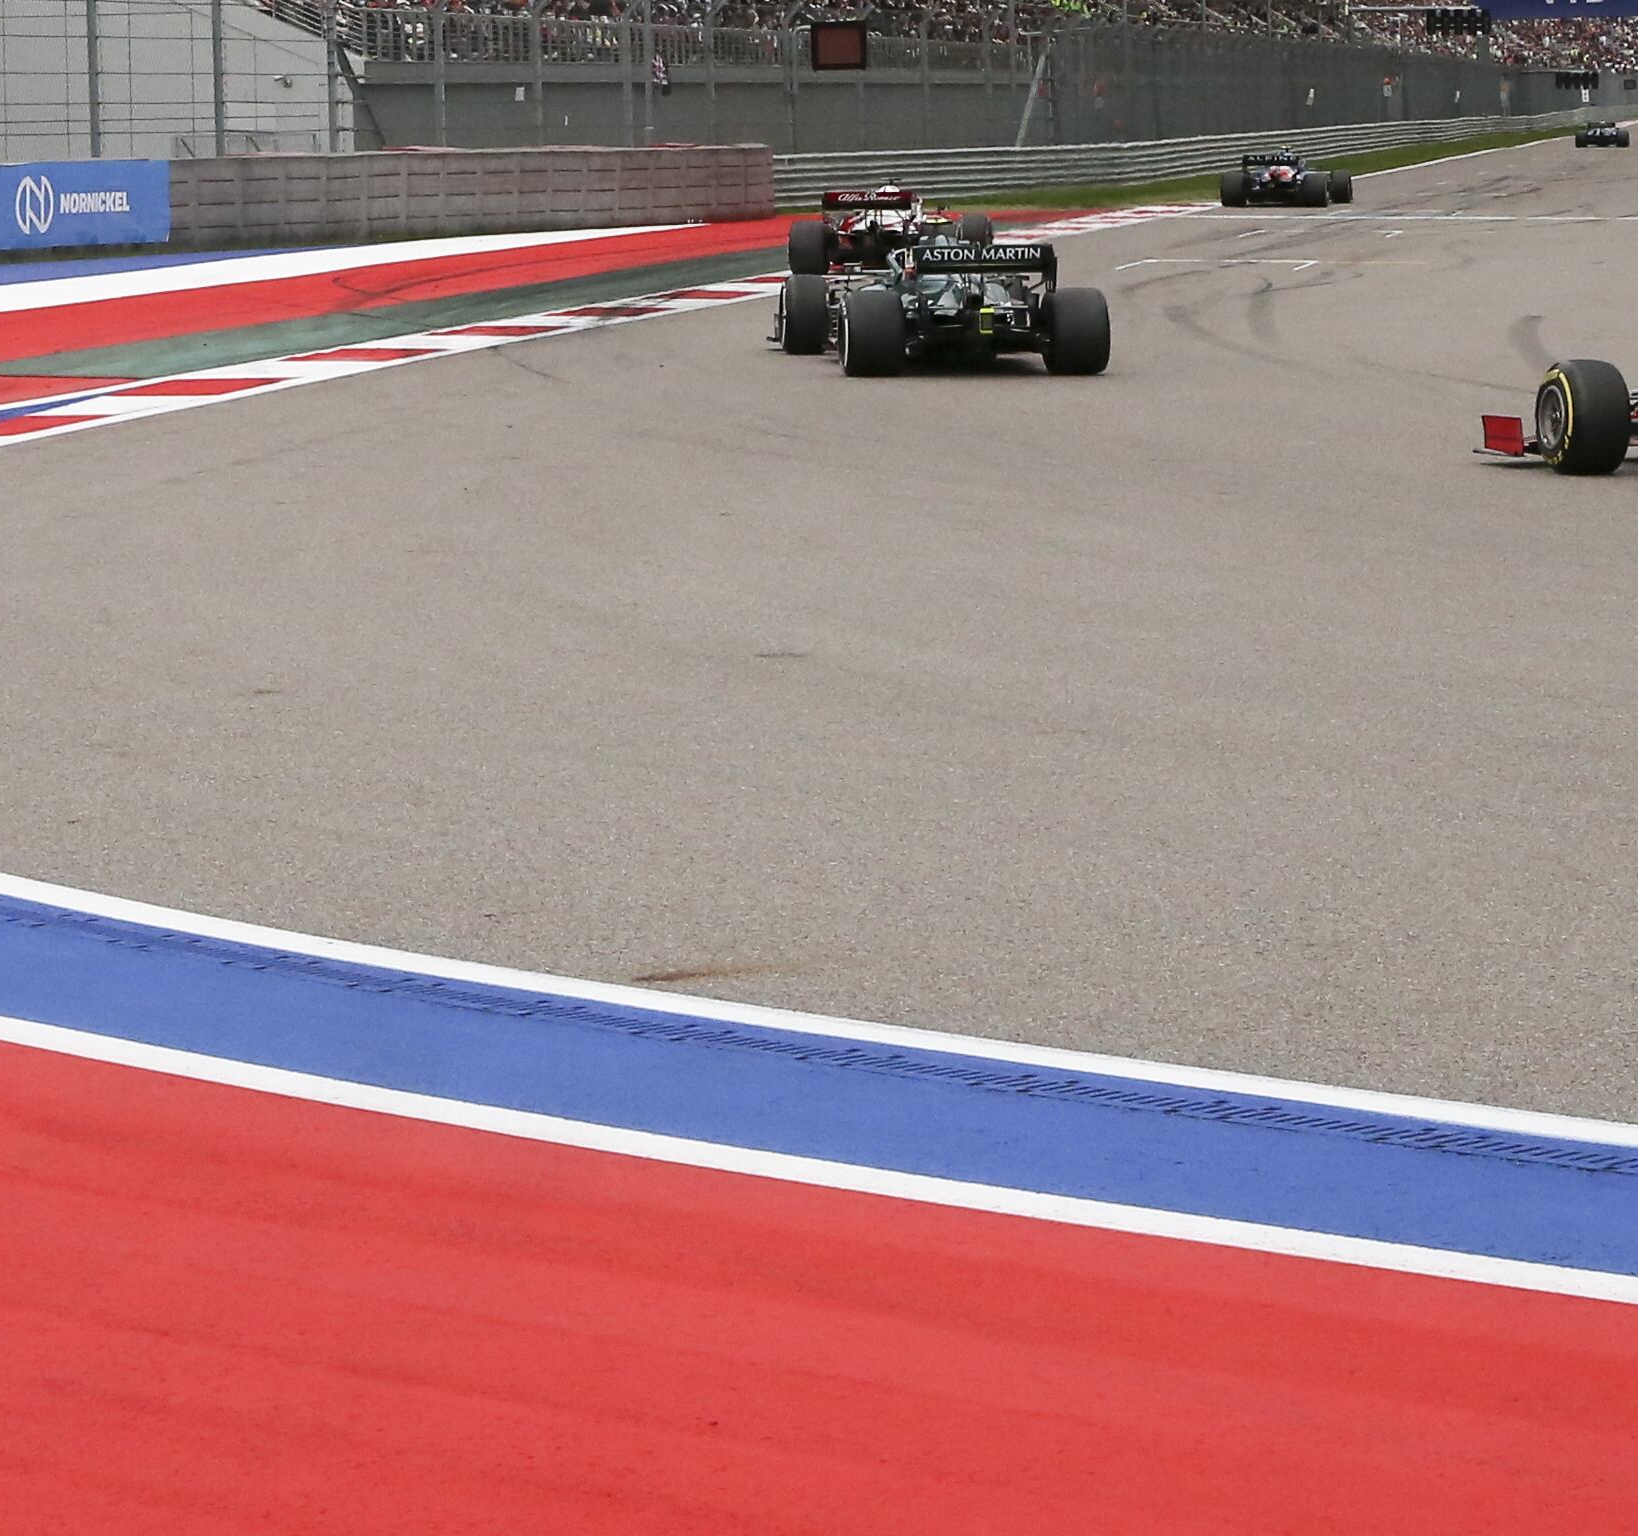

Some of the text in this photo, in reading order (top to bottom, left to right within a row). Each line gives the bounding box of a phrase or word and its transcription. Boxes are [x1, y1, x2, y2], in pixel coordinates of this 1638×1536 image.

[60, 192, 130, 213] NORNICKEL
[838, 192, 862, 202] Alfa
[922, 247, 1041, 261] ASTON MARTIN
